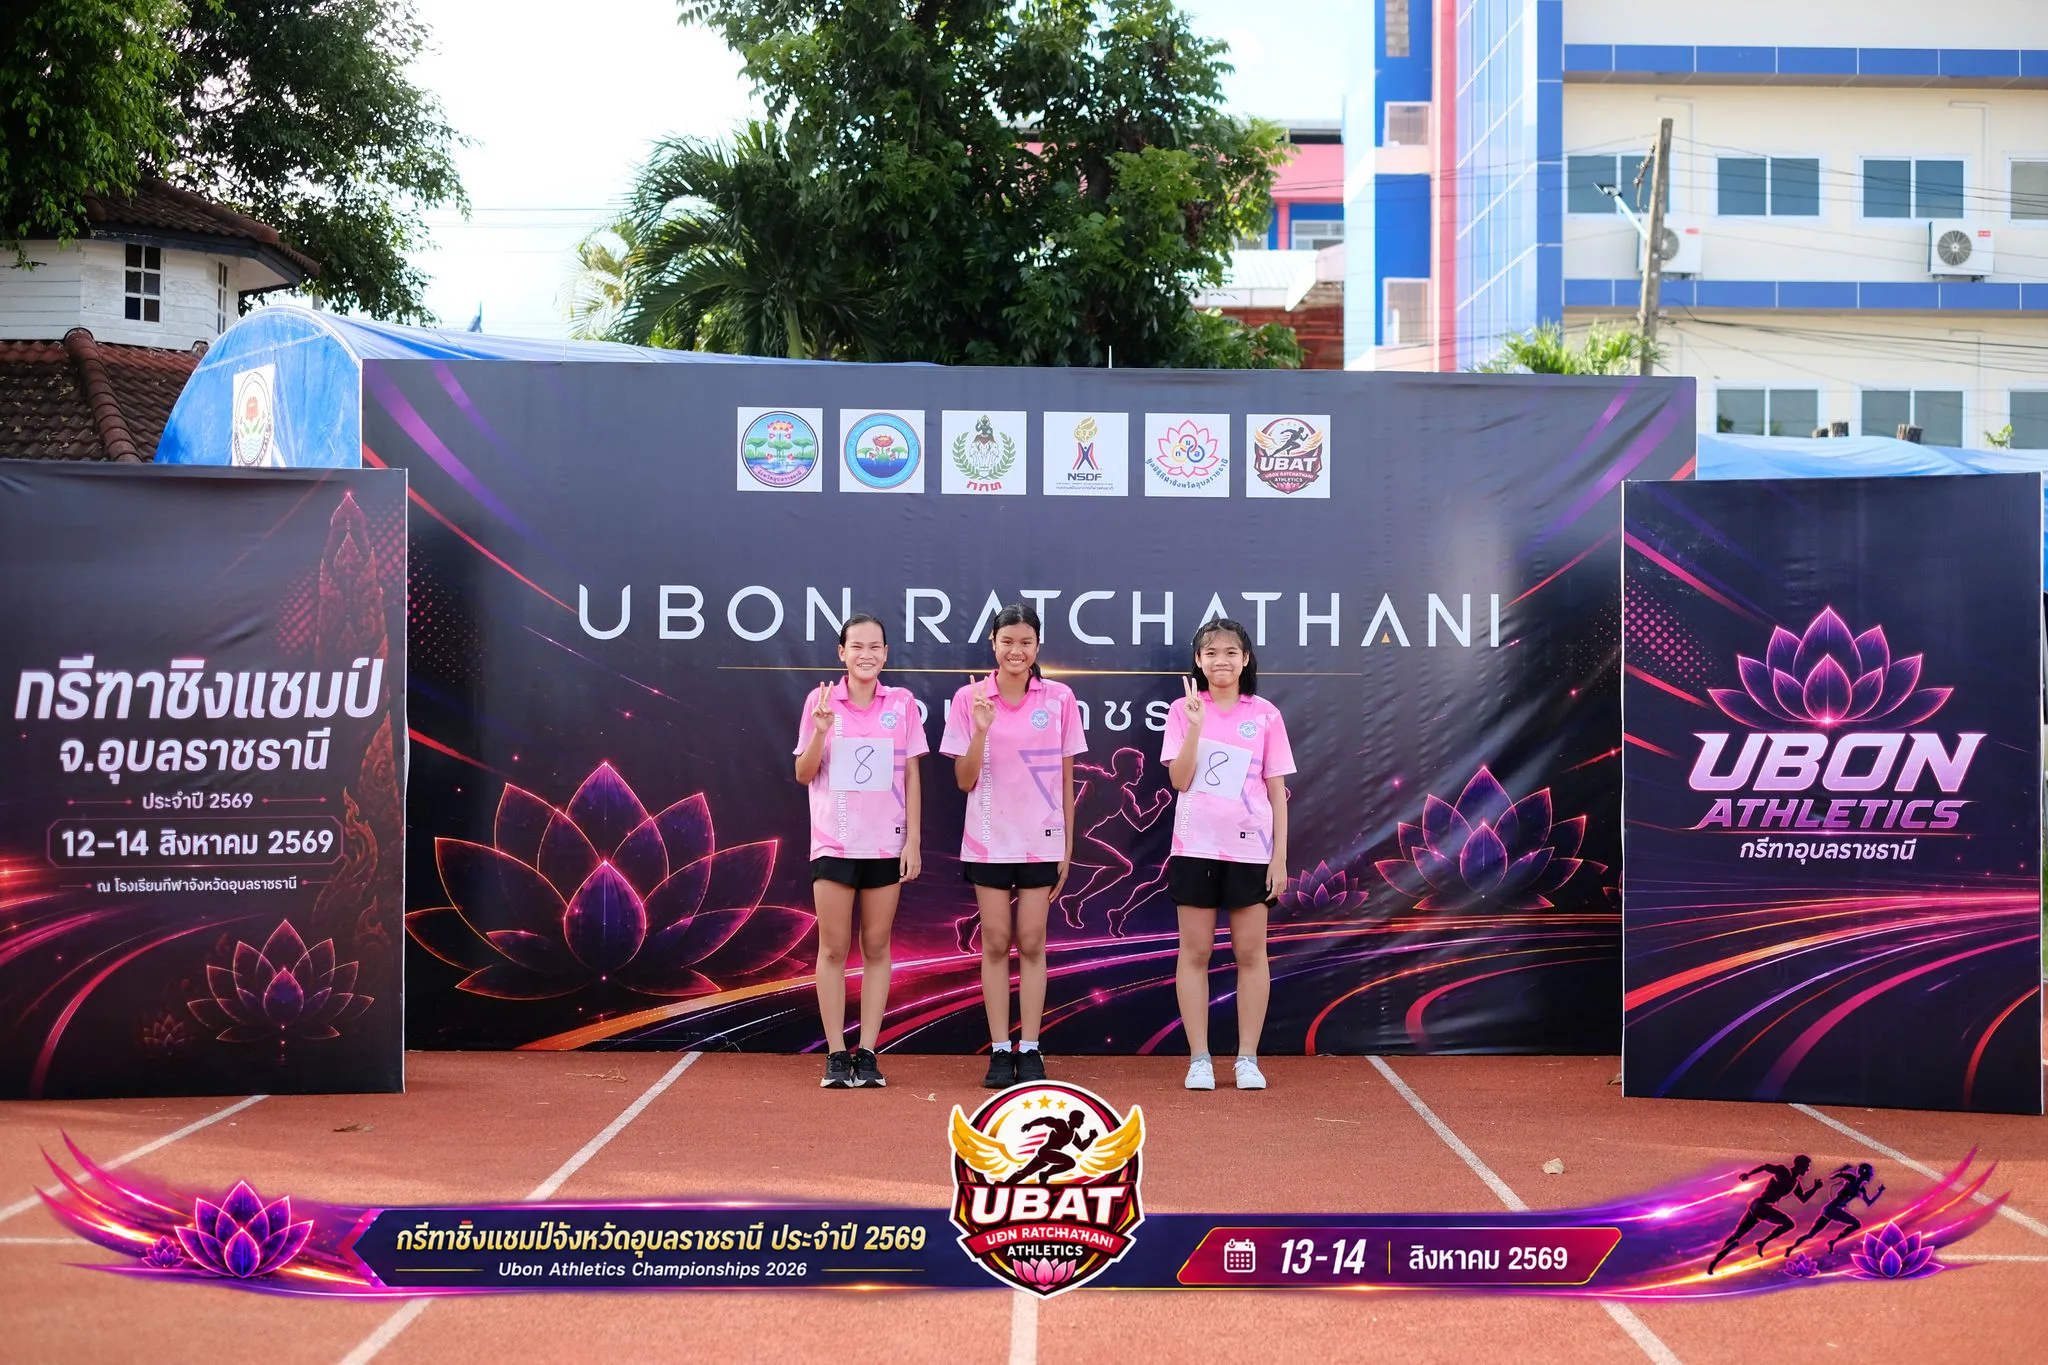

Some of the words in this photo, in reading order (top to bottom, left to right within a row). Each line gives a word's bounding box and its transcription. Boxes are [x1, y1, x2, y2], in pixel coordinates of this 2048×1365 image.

[1067, 472, 1102, 481] NSDF
[1260, 456, 1317, 472] UBAT
[578, 584, 851, 641] UBON
[905, 588, 1499, 648] RATCHATHANI
[15, 655, 384, 720] กรีฑาชิงแชมป์
[59, 727, 332, 785] จ.อุบลราชธานี
[853, 745, 875, 785] 8
[1204, 750, 1230, 787] 8
[1688, 732, 1988, 793] UBON
[142, 791, 204, 810] ประจำปี
[209, 793, 254, 809] 2569
[1692, 798, 1972, 830] ATHLETICS
[159, 829, 258, 856] สิงหาคม
[268, 830, 334, 854] 2569
[1739, 837, 1917, 865] กรีฑาอุบลราชธานี
[97, 882, 111, 893] ณ
